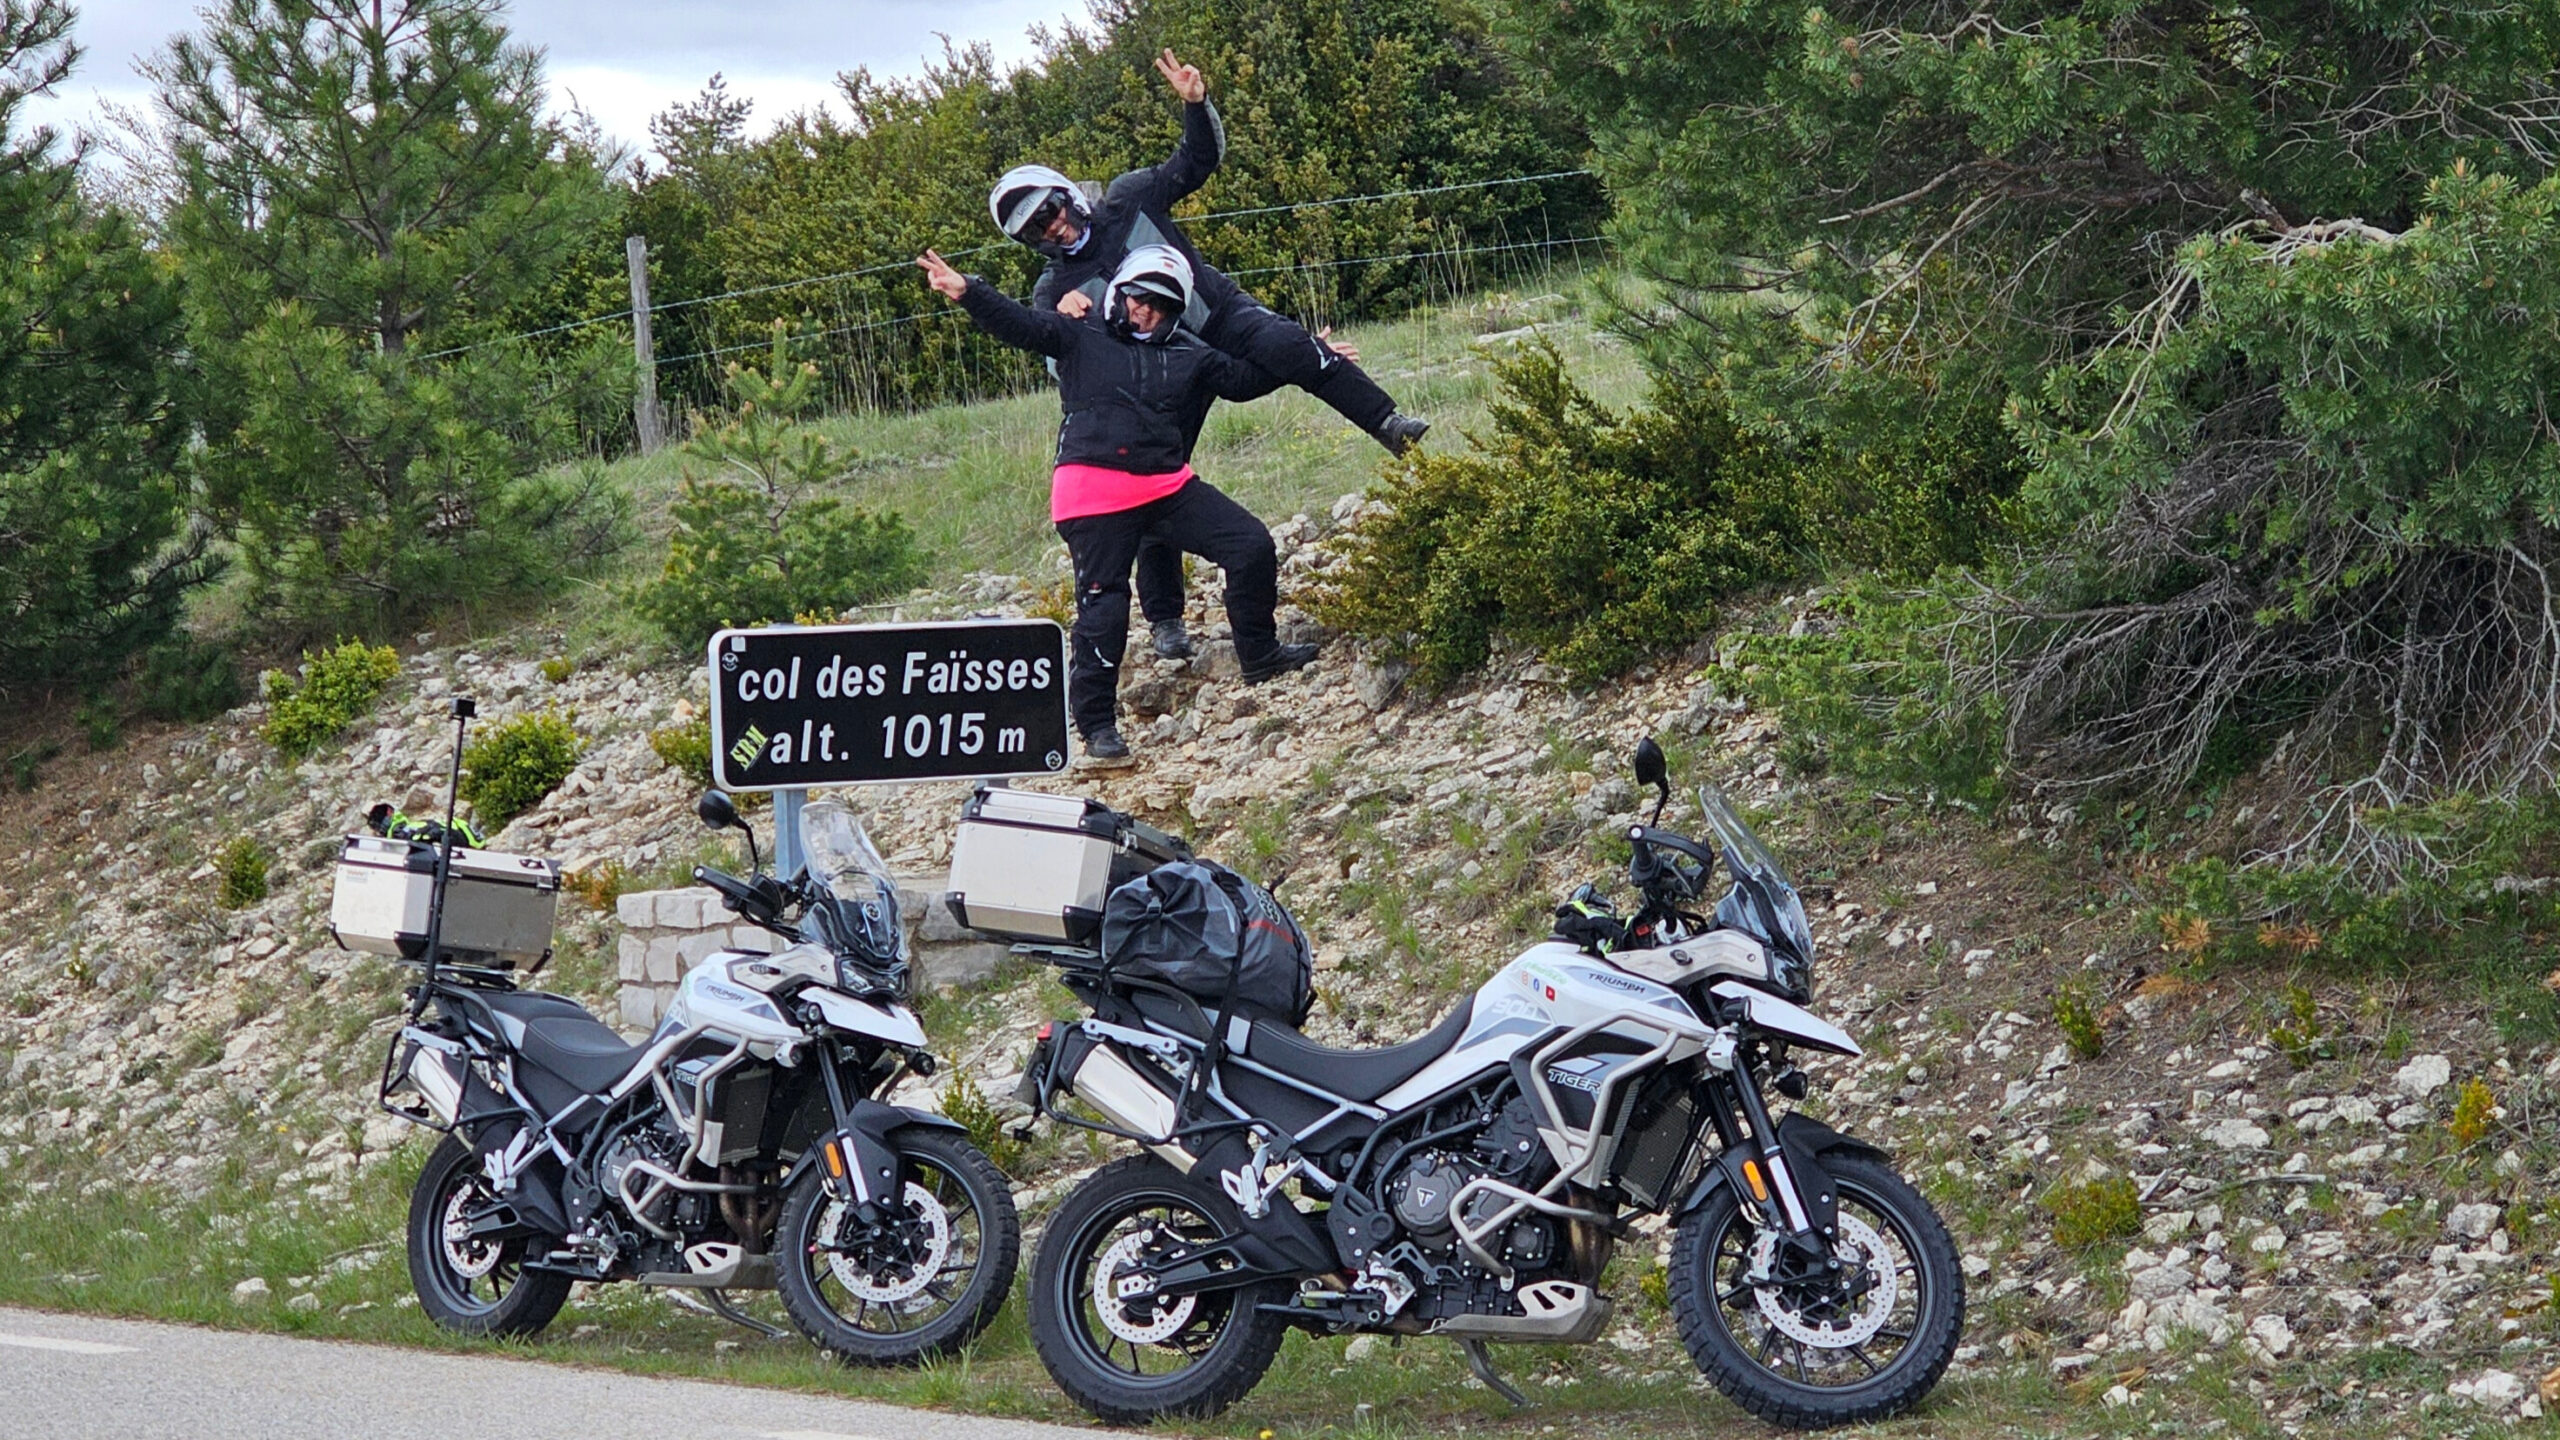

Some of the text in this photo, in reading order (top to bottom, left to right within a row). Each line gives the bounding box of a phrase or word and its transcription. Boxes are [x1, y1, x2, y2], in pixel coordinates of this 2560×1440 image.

[738, 650, 1051, 702] col des Faïsses
[770, 712, 1026, 764] alt. 1015 m
[1588, 972, 1646, 994] TRIUMPH
[1547, 1068, 1601, 1094] TIGER
